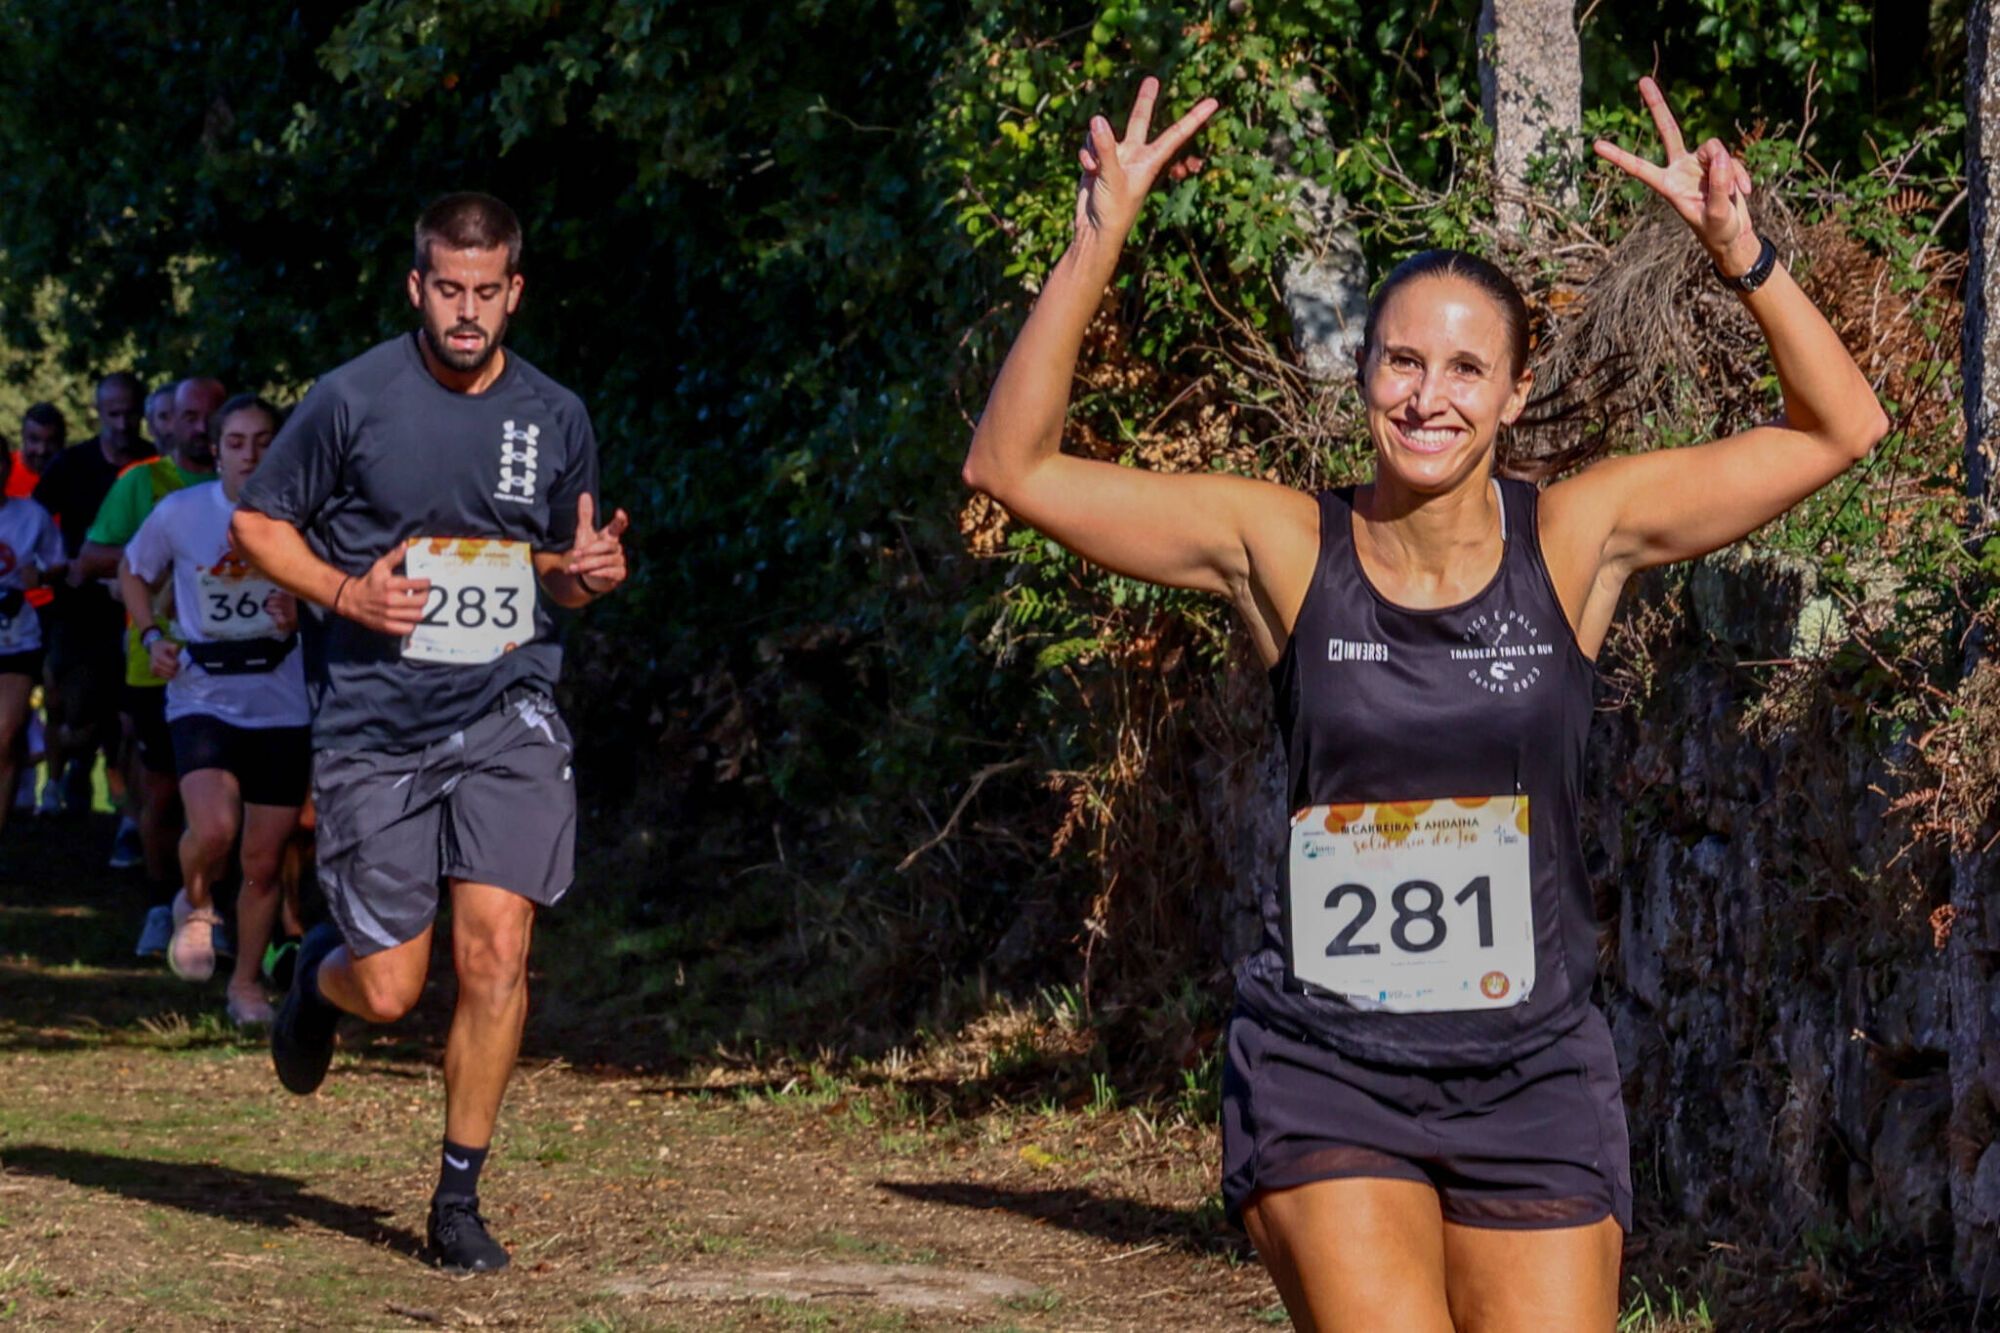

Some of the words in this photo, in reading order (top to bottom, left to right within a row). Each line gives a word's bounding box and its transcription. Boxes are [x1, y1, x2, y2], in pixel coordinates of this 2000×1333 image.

[209, 589, 277, 622] 36
[416, 585, 519, 629] 283
[1500, 644, 1527, 657] TRAIL
[1537, 643, 1554, 655] RUN
[1351, 822, 1411, 835] CARREIRA
[1424, 816, 1479, 831] ANDAINA
[1324, 875, 1494, 957] 281
